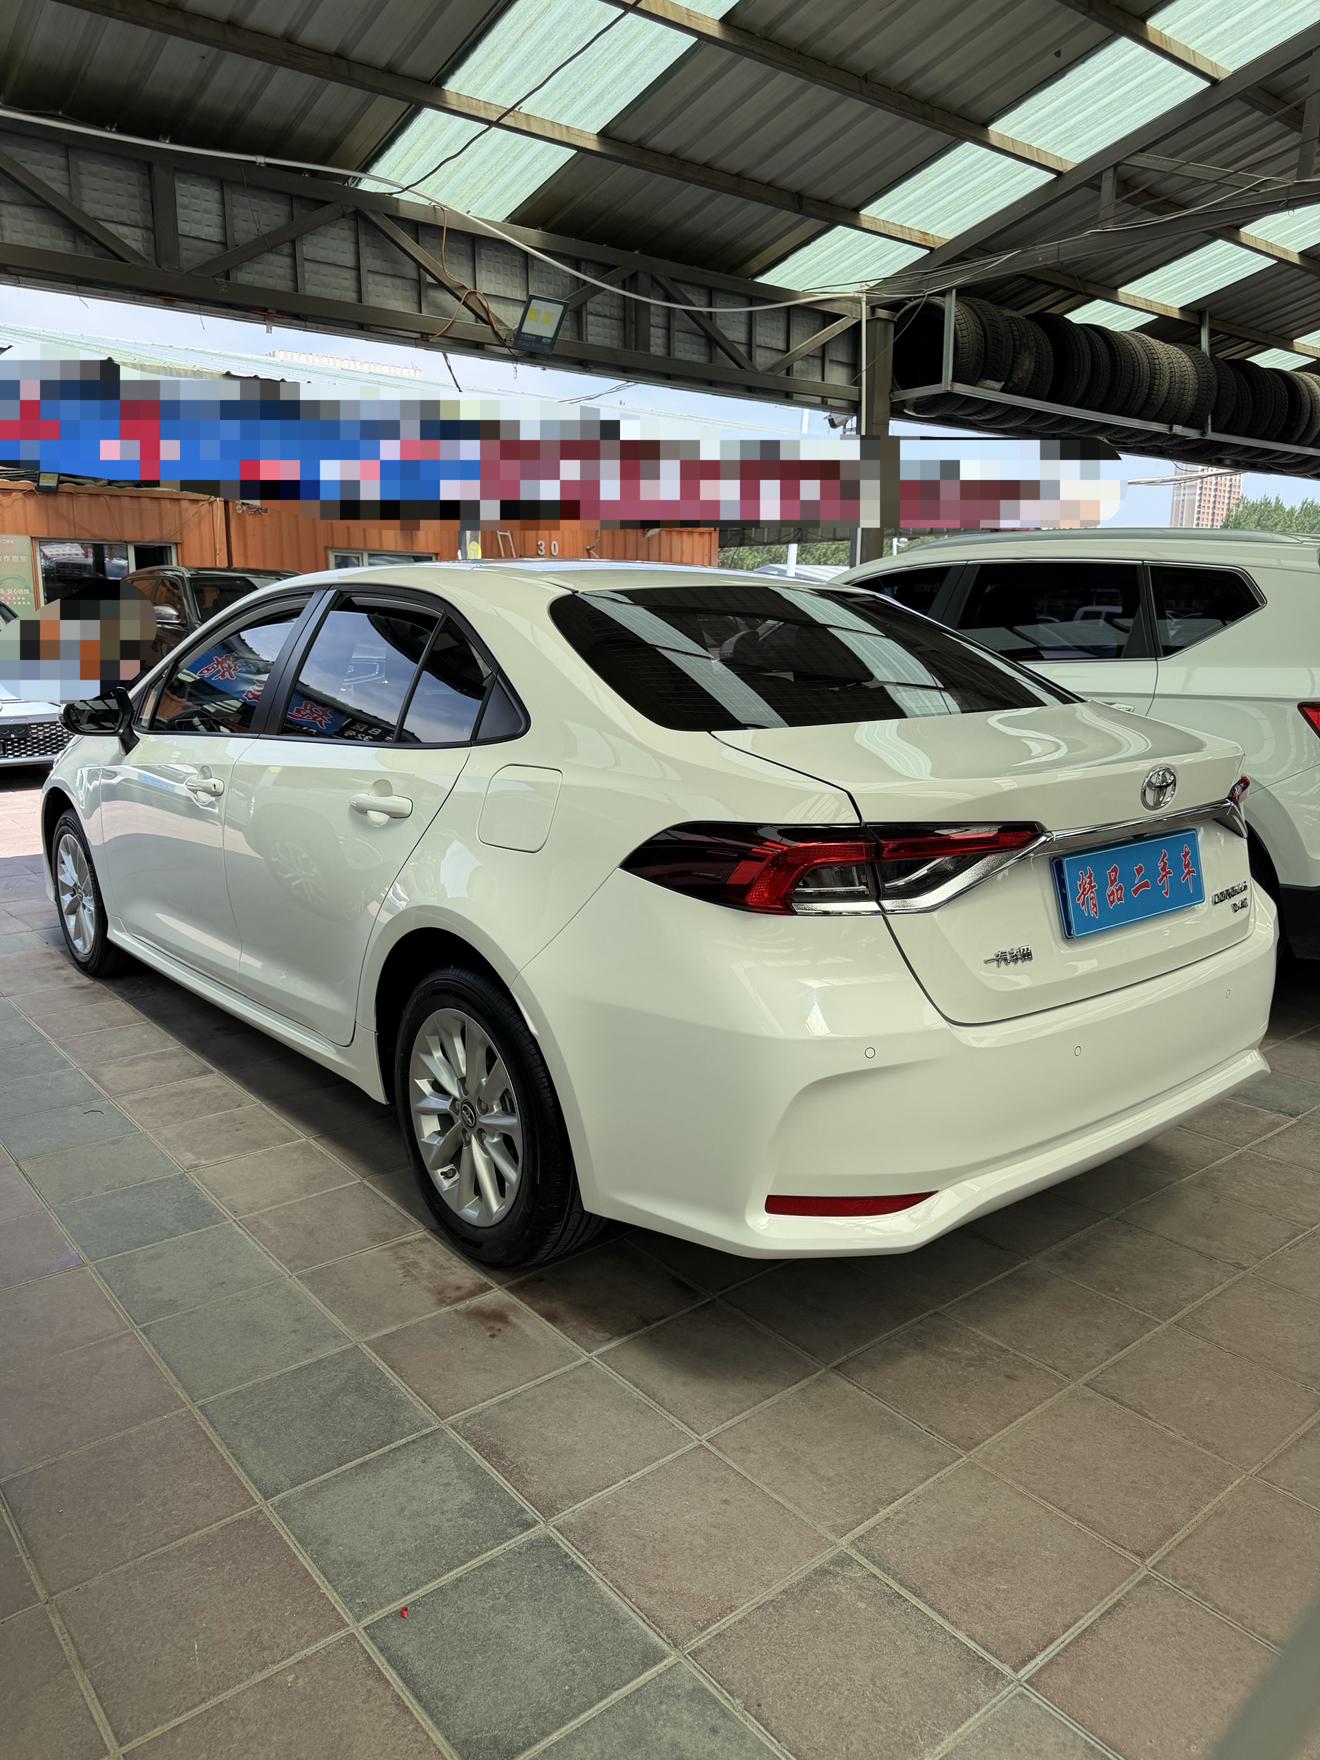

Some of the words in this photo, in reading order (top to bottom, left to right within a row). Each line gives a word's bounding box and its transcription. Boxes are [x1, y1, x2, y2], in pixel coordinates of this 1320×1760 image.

[537, 540, 559, 556] 30
[1076, 844, 1197, 919] 精品二手车
